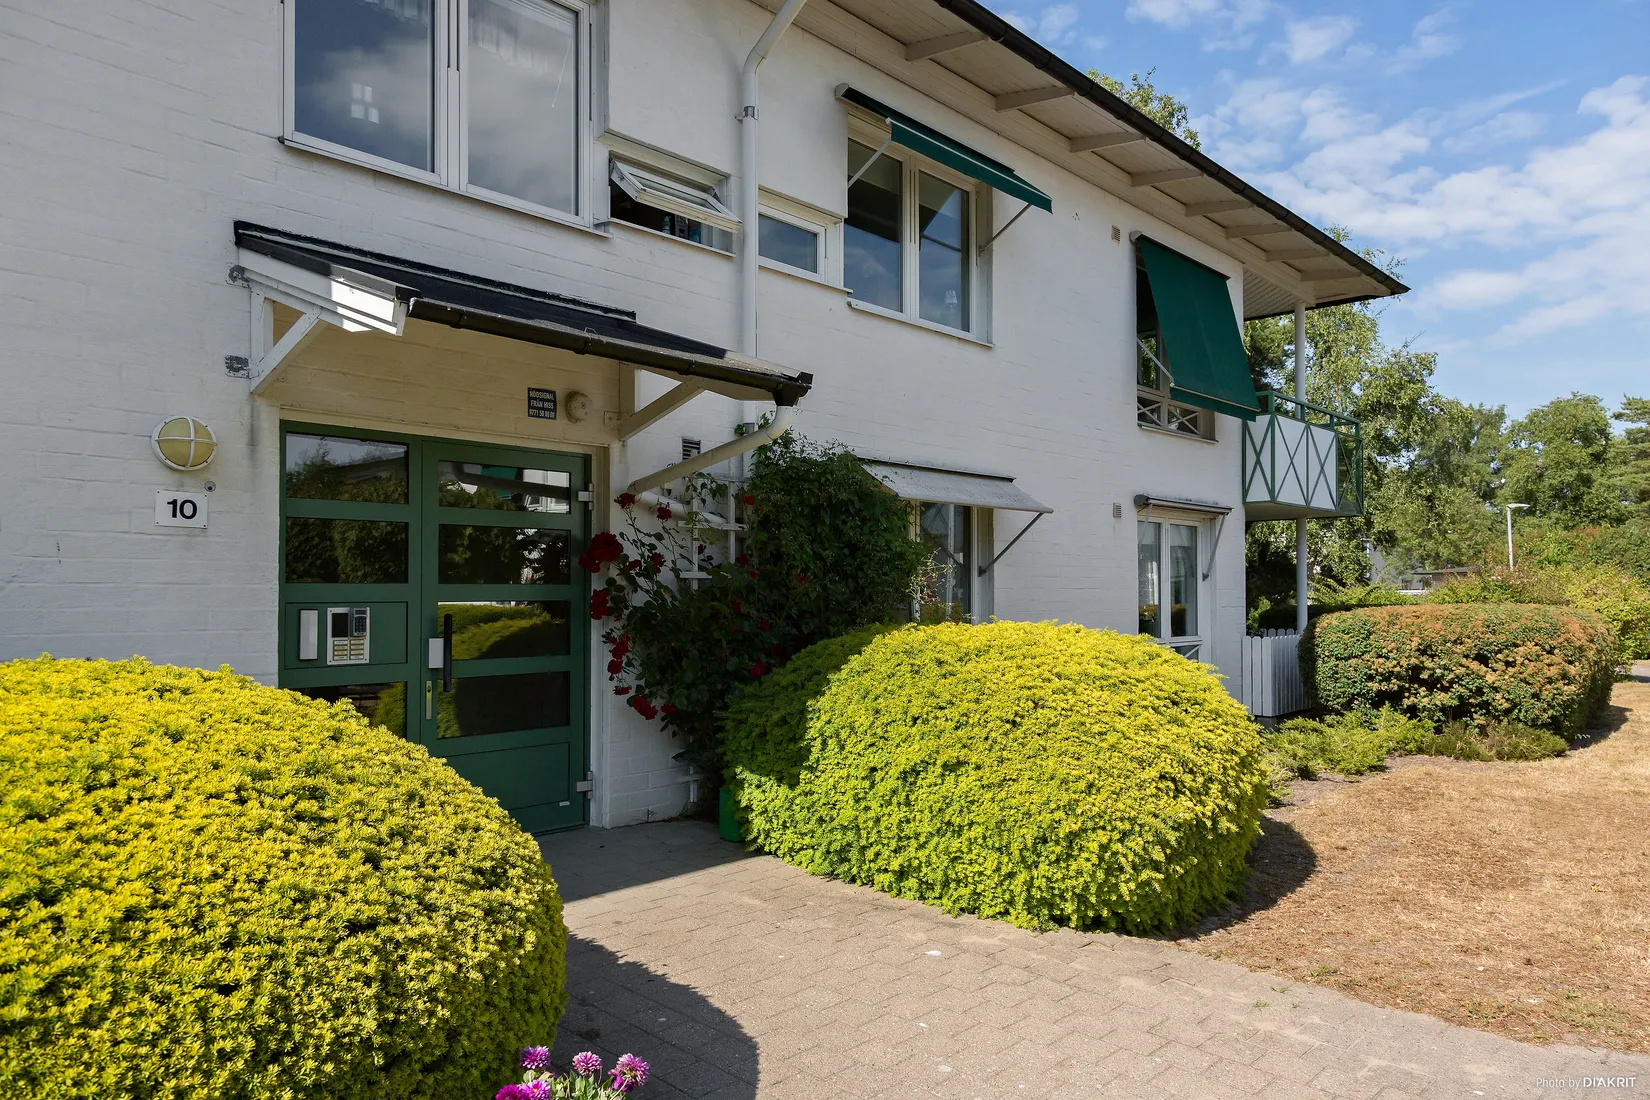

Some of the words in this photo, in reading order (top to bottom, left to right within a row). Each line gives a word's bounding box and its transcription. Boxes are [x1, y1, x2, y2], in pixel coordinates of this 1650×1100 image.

[530, 390, 554, 400] NÖDSIGNAL
[530, 400, 543, 408] FRÅN
[167, 499, 197, 519] 10
